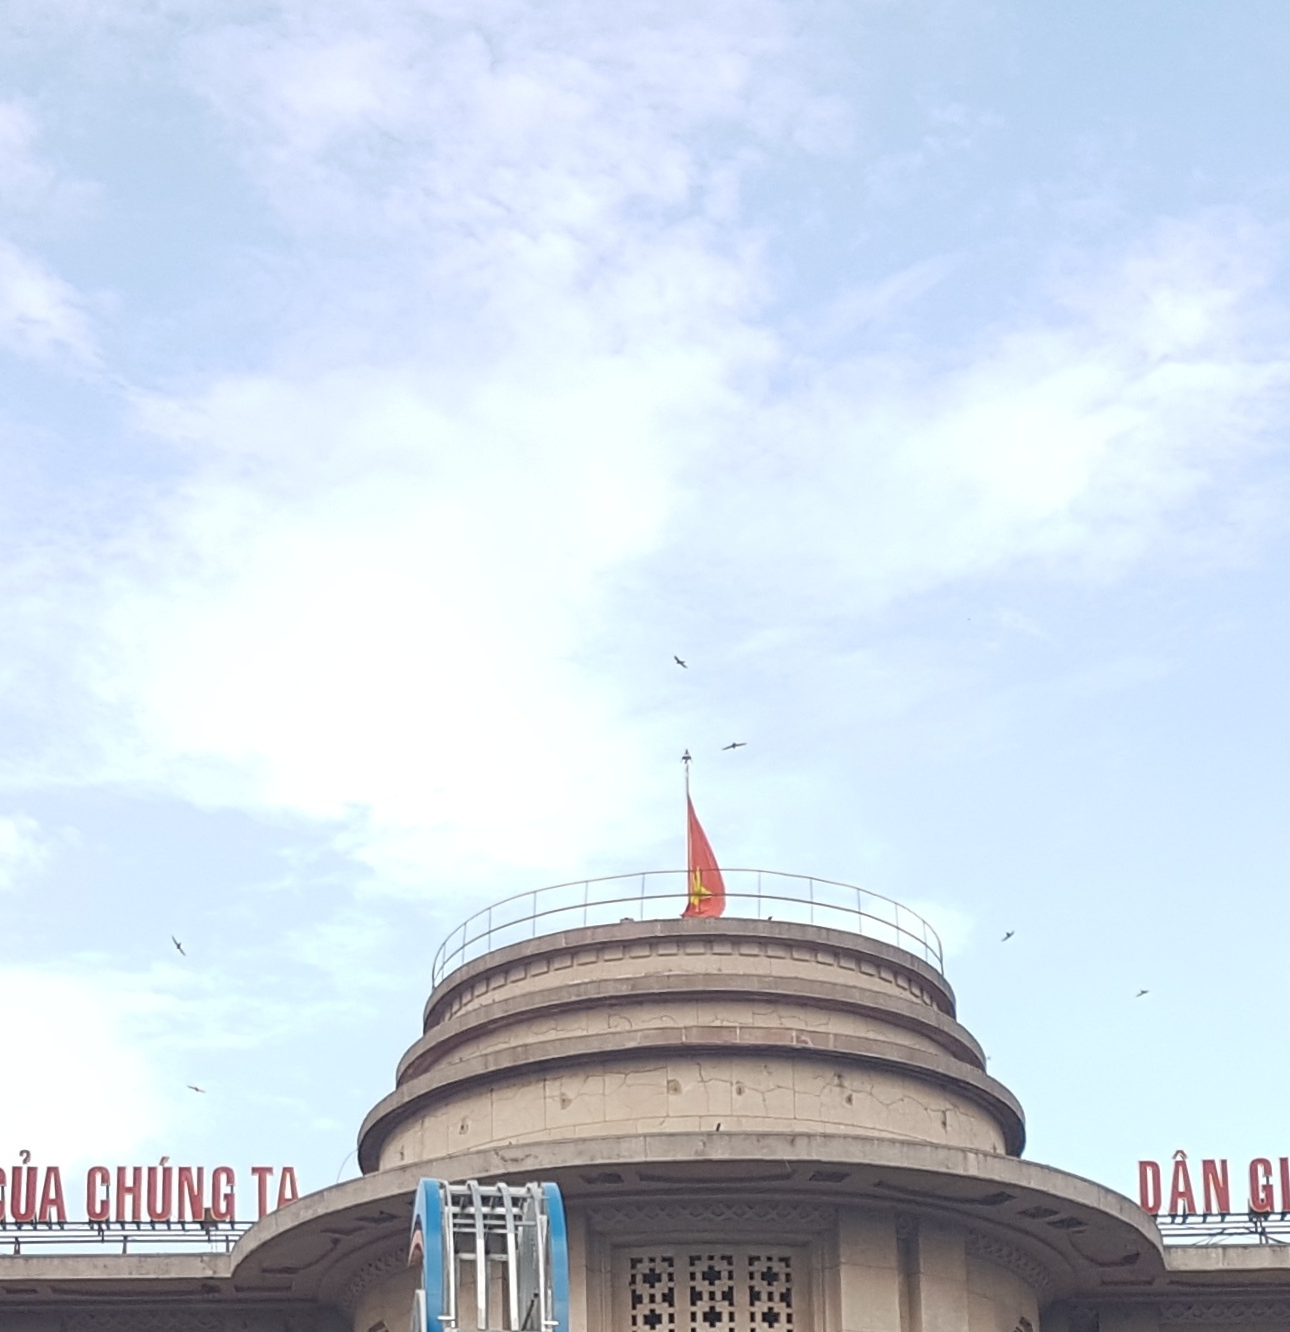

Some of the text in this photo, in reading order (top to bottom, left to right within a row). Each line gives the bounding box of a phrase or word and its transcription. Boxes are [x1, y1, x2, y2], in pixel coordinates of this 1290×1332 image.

[87, 1156, 235, 1222] CHÚNG
[251, 1166, 299, 1219] TA
[1138, 1149, 1230, 1214] DÂN
